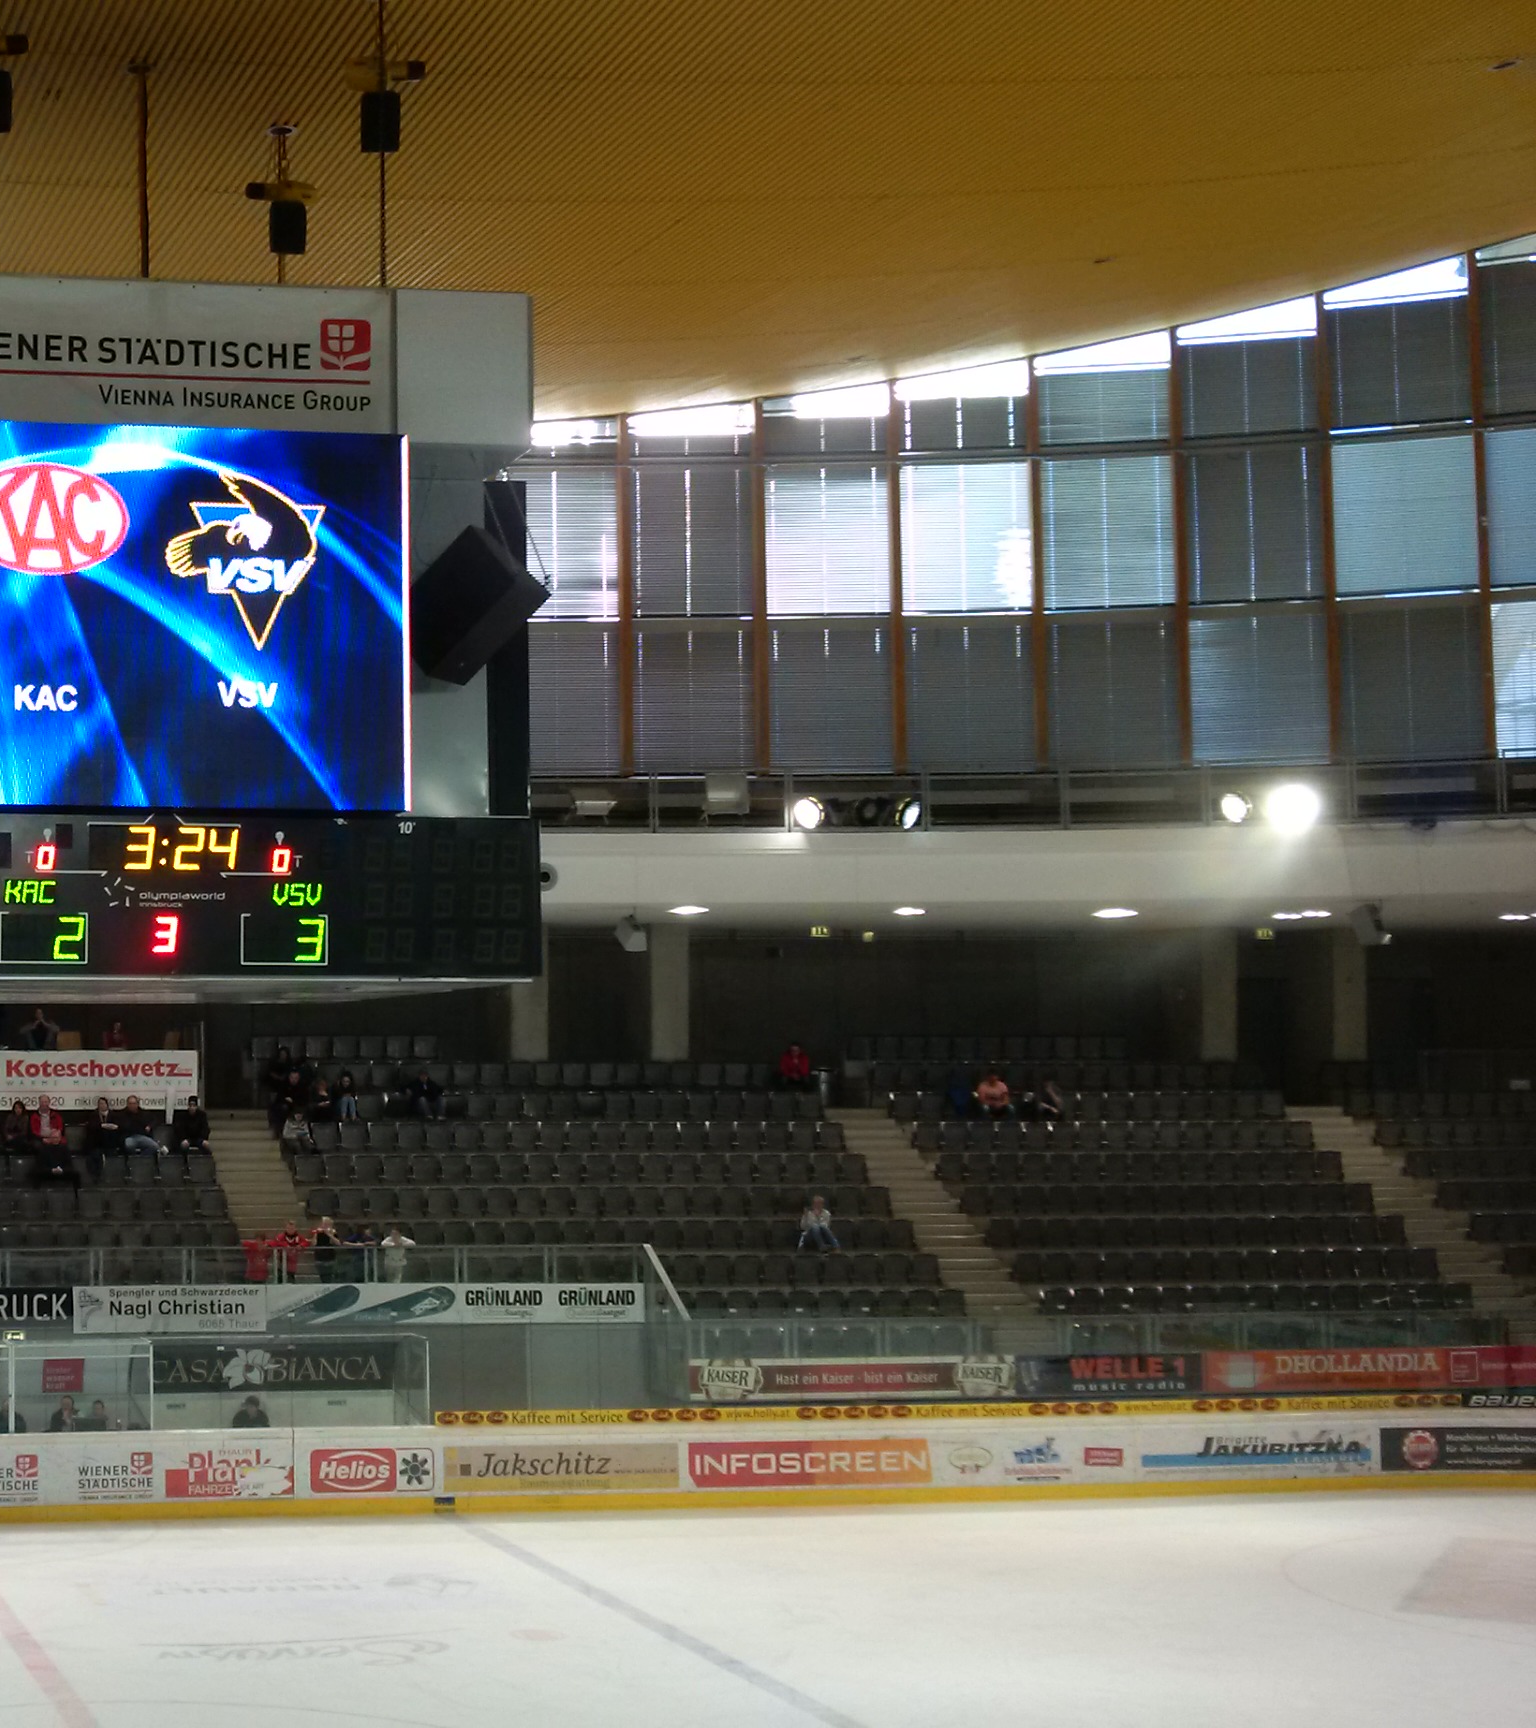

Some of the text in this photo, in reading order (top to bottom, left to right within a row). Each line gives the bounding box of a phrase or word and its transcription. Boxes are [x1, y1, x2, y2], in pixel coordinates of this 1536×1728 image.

[97, 337, 312, 370] STÄDTISCHE
[208, 557, 314, 593] VSV
[13, 684, 79, 711] KAC
[217, 679, 279, 709] VSV
[35, 844, 58, 871] 0
[123, 826, 240, 871] 3:24
[271, 847, 293, 875] 0
[4, 879, 57, 905] KAC
[139, 891, 227, 904] olympiaworld
[272, 882, 323, 907] VSV
[52, 915, 86, 961] 2
[151, 915, 179, 953] 3
[294, 918, 326, 962] 3
[5, 1059, 180, 1078] Koteschowetz
[109, 1287, 260, 1298] Spengler und Schwarzdecker
[465, 1287, 543, 1306] GRÜNLAND
[558, 1287, 636, 1306] GRÜNLAND
[109, 1300, 246, 1318] Nagl Christian
[229, 1319, 260, 1329] Thaur
[153, 1359, 227, 1384] CASA
[1069, 1357, 1186, 1379] WELLE 1
[1275, 1352, 1440, 1374] DHOLLANDIA
[706, 1368, 749, 1387] KAISER
[776, 1372, 939, 1385] Hast ein Kaiser bist ein Kaiser
[1073, 1381, 1186, 1392] music radio
[511, 1411, 624, 1425] Kaffee mit Service
[916, 1405, 1024, 1418] Kaffee mit Service
[1197, 1436, 1362, 1457] JAKUBITZKA
[78, 1465, 130, 1477] WIENER
[319, 1459, 391, 1480] Helios
[477, 1451, 612, 1478] Jakschitz
[695, 1450, 929, 1477] INFOSCREEN
[78, 1476, 154, 1489] STÄDTISCHE
